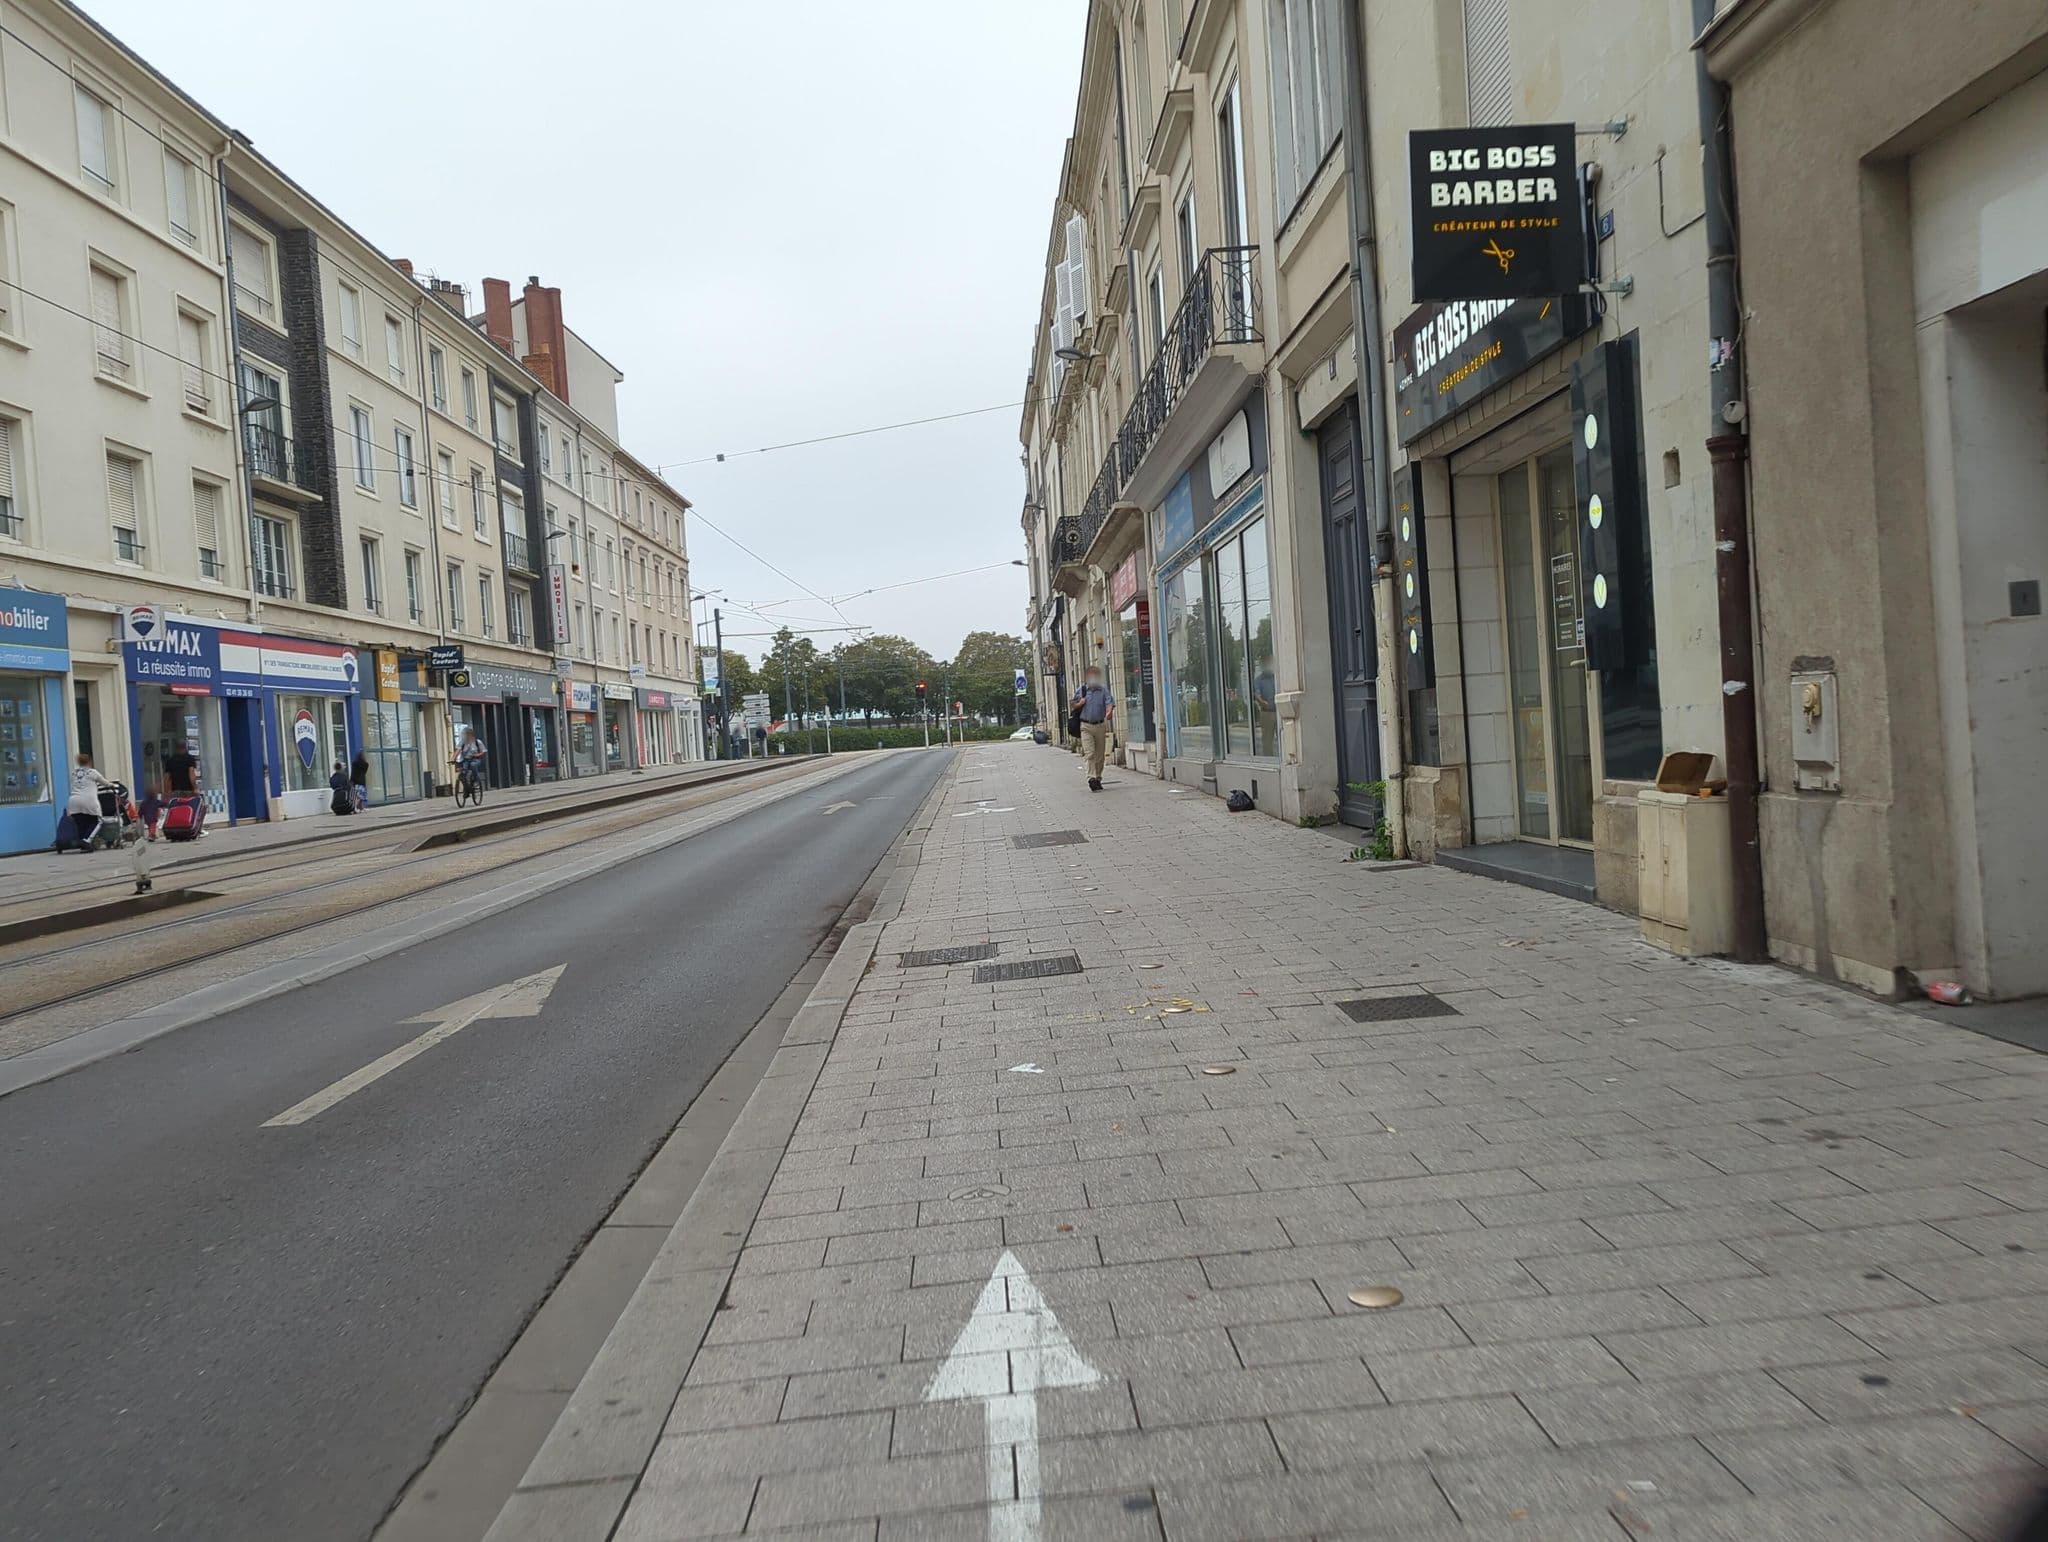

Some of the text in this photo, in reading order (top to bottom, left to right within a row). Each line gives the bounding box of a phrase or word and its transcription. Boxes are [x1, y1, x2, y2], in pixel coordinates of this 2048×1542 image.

[1429, 145, 1557, 172] BIG BOSS
[1430, 177, 1558, 207] BARBER
[1433, 217, 1560, 232] CRÉATEUR DE STYLE
[1415, 321, 1437, 377] BIG
[1437, 300, 1468, 360] BOSS
[553, 568, 564, 640] IMMOBILIER
[137, 657, 212, 679] La réussite immo
